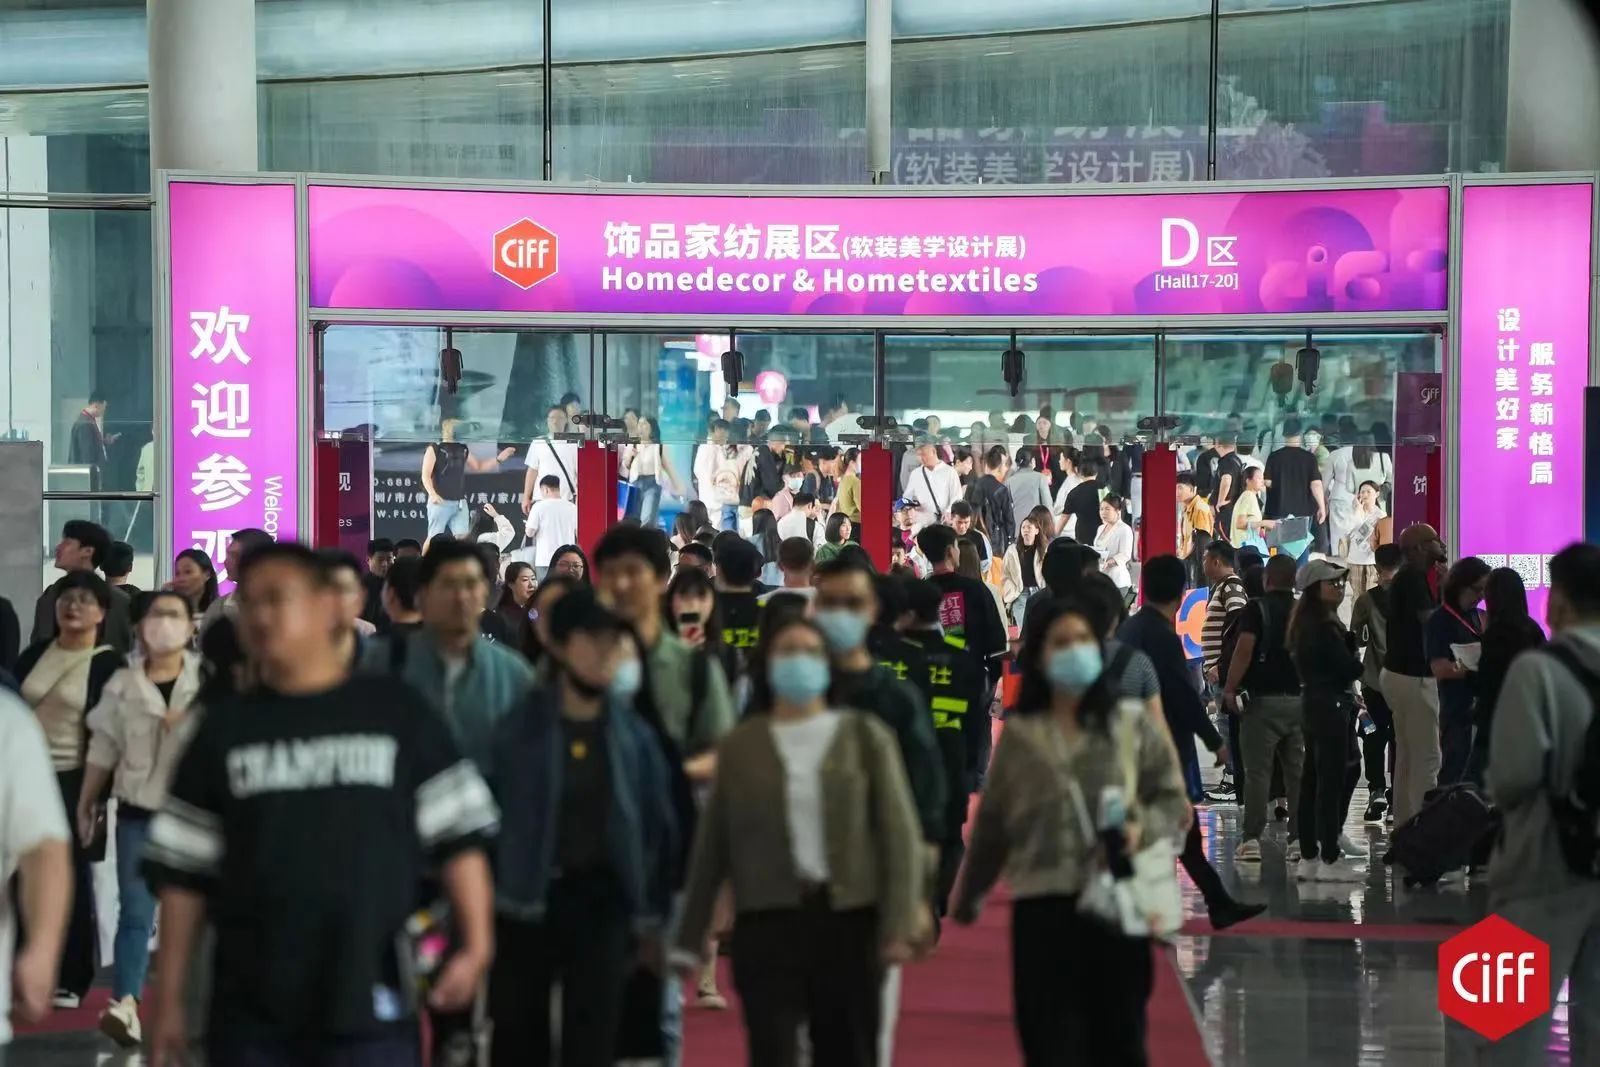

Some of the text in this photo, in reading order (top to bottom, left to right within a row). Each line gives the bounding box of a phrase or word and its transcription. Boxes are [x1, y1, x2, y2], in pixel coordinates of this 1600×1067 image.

[602, 266, 1038, 293] Homedecor & Hometextiles
[1496, 307, 1520, 450] 设计美好家
[1528, 342, 1555, 485] 服务新格局
